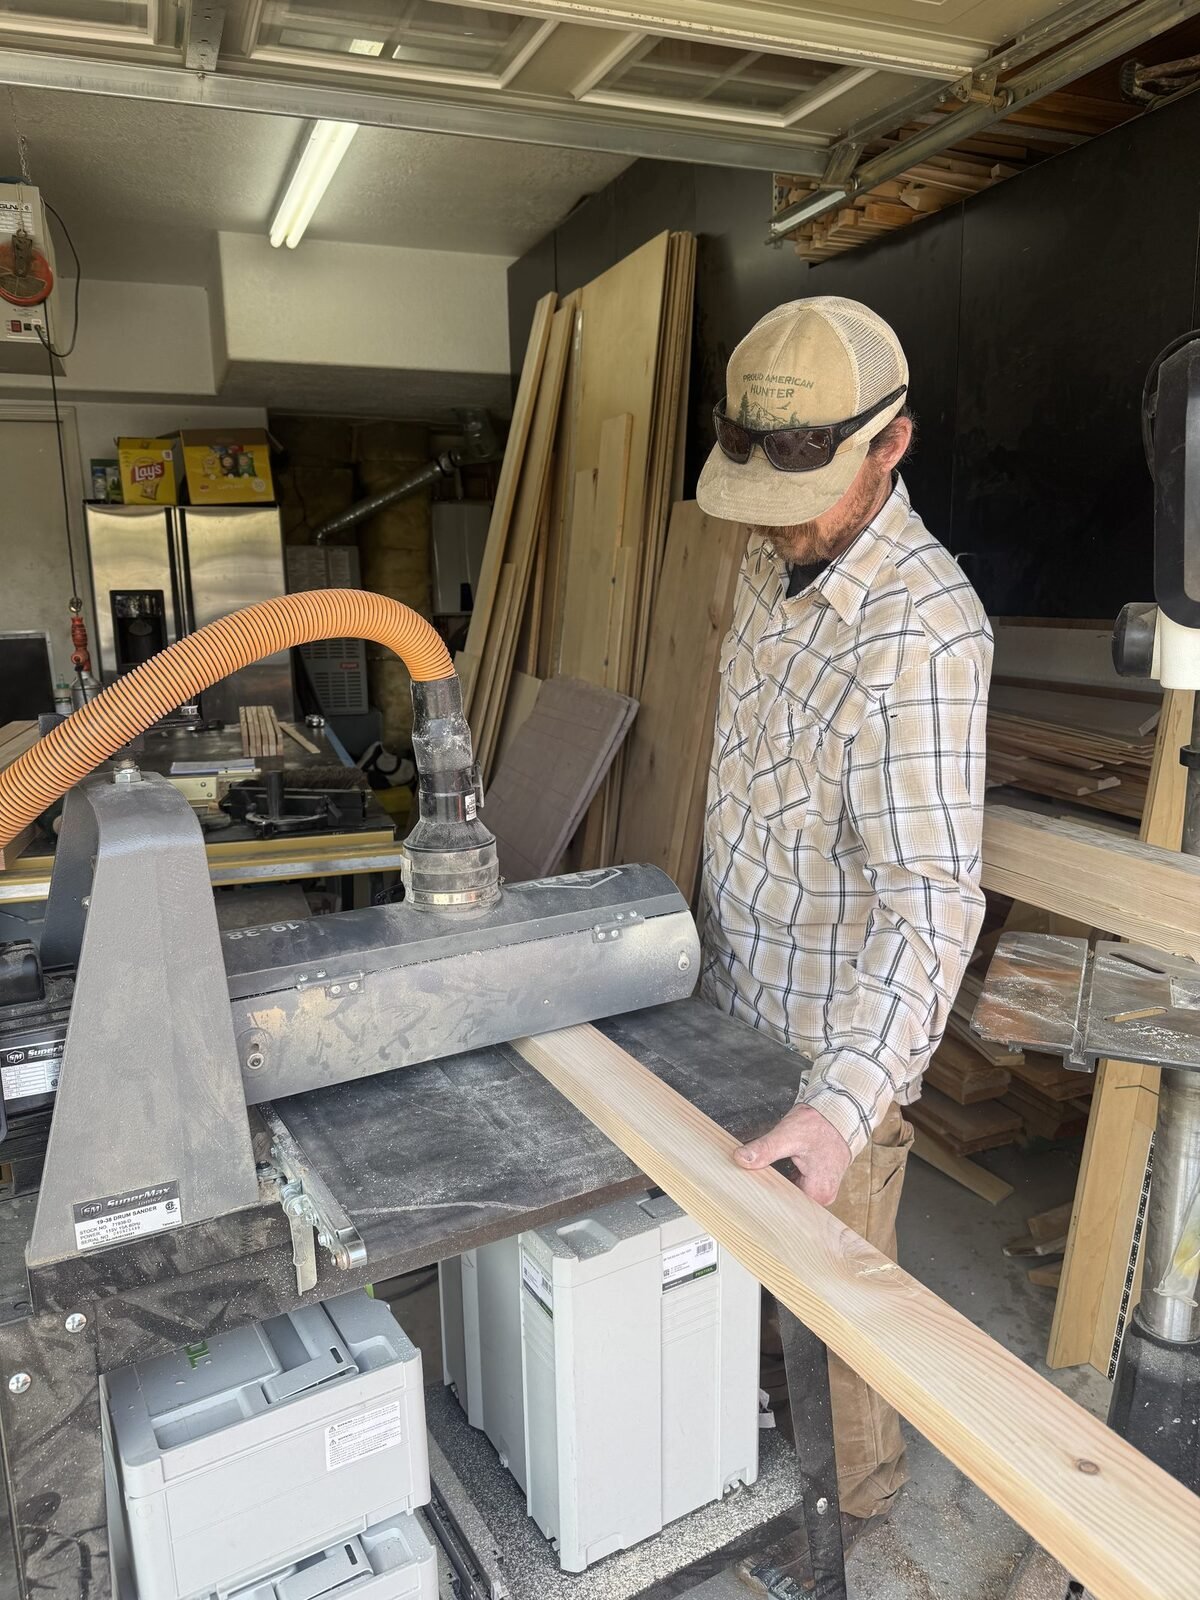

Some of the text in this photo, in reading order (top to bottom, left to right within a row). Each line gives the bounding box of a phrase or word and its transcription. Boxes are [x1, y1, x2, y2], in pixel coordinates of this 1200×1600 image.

[743, 373, 814, 389] PROUD AMERICAN
[750, 384, 795, 398] HUNTER
[107, 1187, 170, 1207] SuperMax
[113, 1212, 131, 1221] DRUM
[132, 1206, 157, 1216] SANDER
